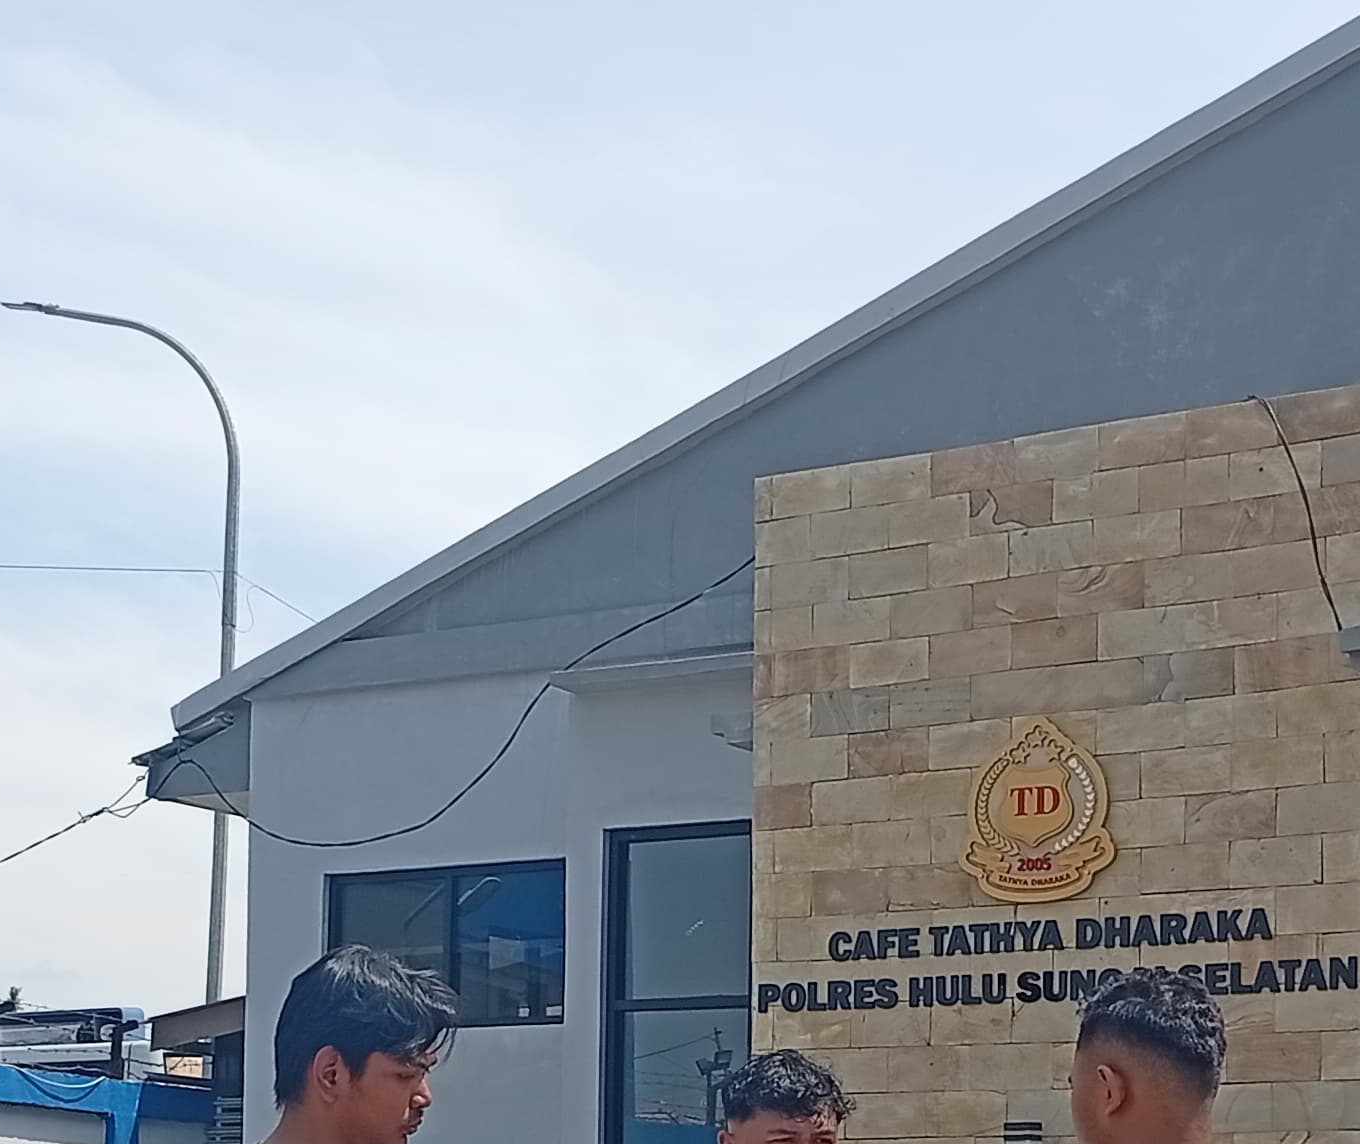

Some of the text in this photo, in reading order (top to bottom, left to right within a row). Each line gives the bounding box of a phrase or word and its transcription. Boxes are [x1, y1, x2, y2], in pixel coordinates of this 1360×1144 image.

[1010, 786, 1060, 816] TD
[1017, 857, 1052, 871] 2005
[998, 873, 1071, 886] TATHYA DHARAKA
[828, 908, 1273, 961] CAFE TATHYA DHARAKA
[757, 979, 899, 1013] POLRES
[909, 973, 1006, 1007] HULU
